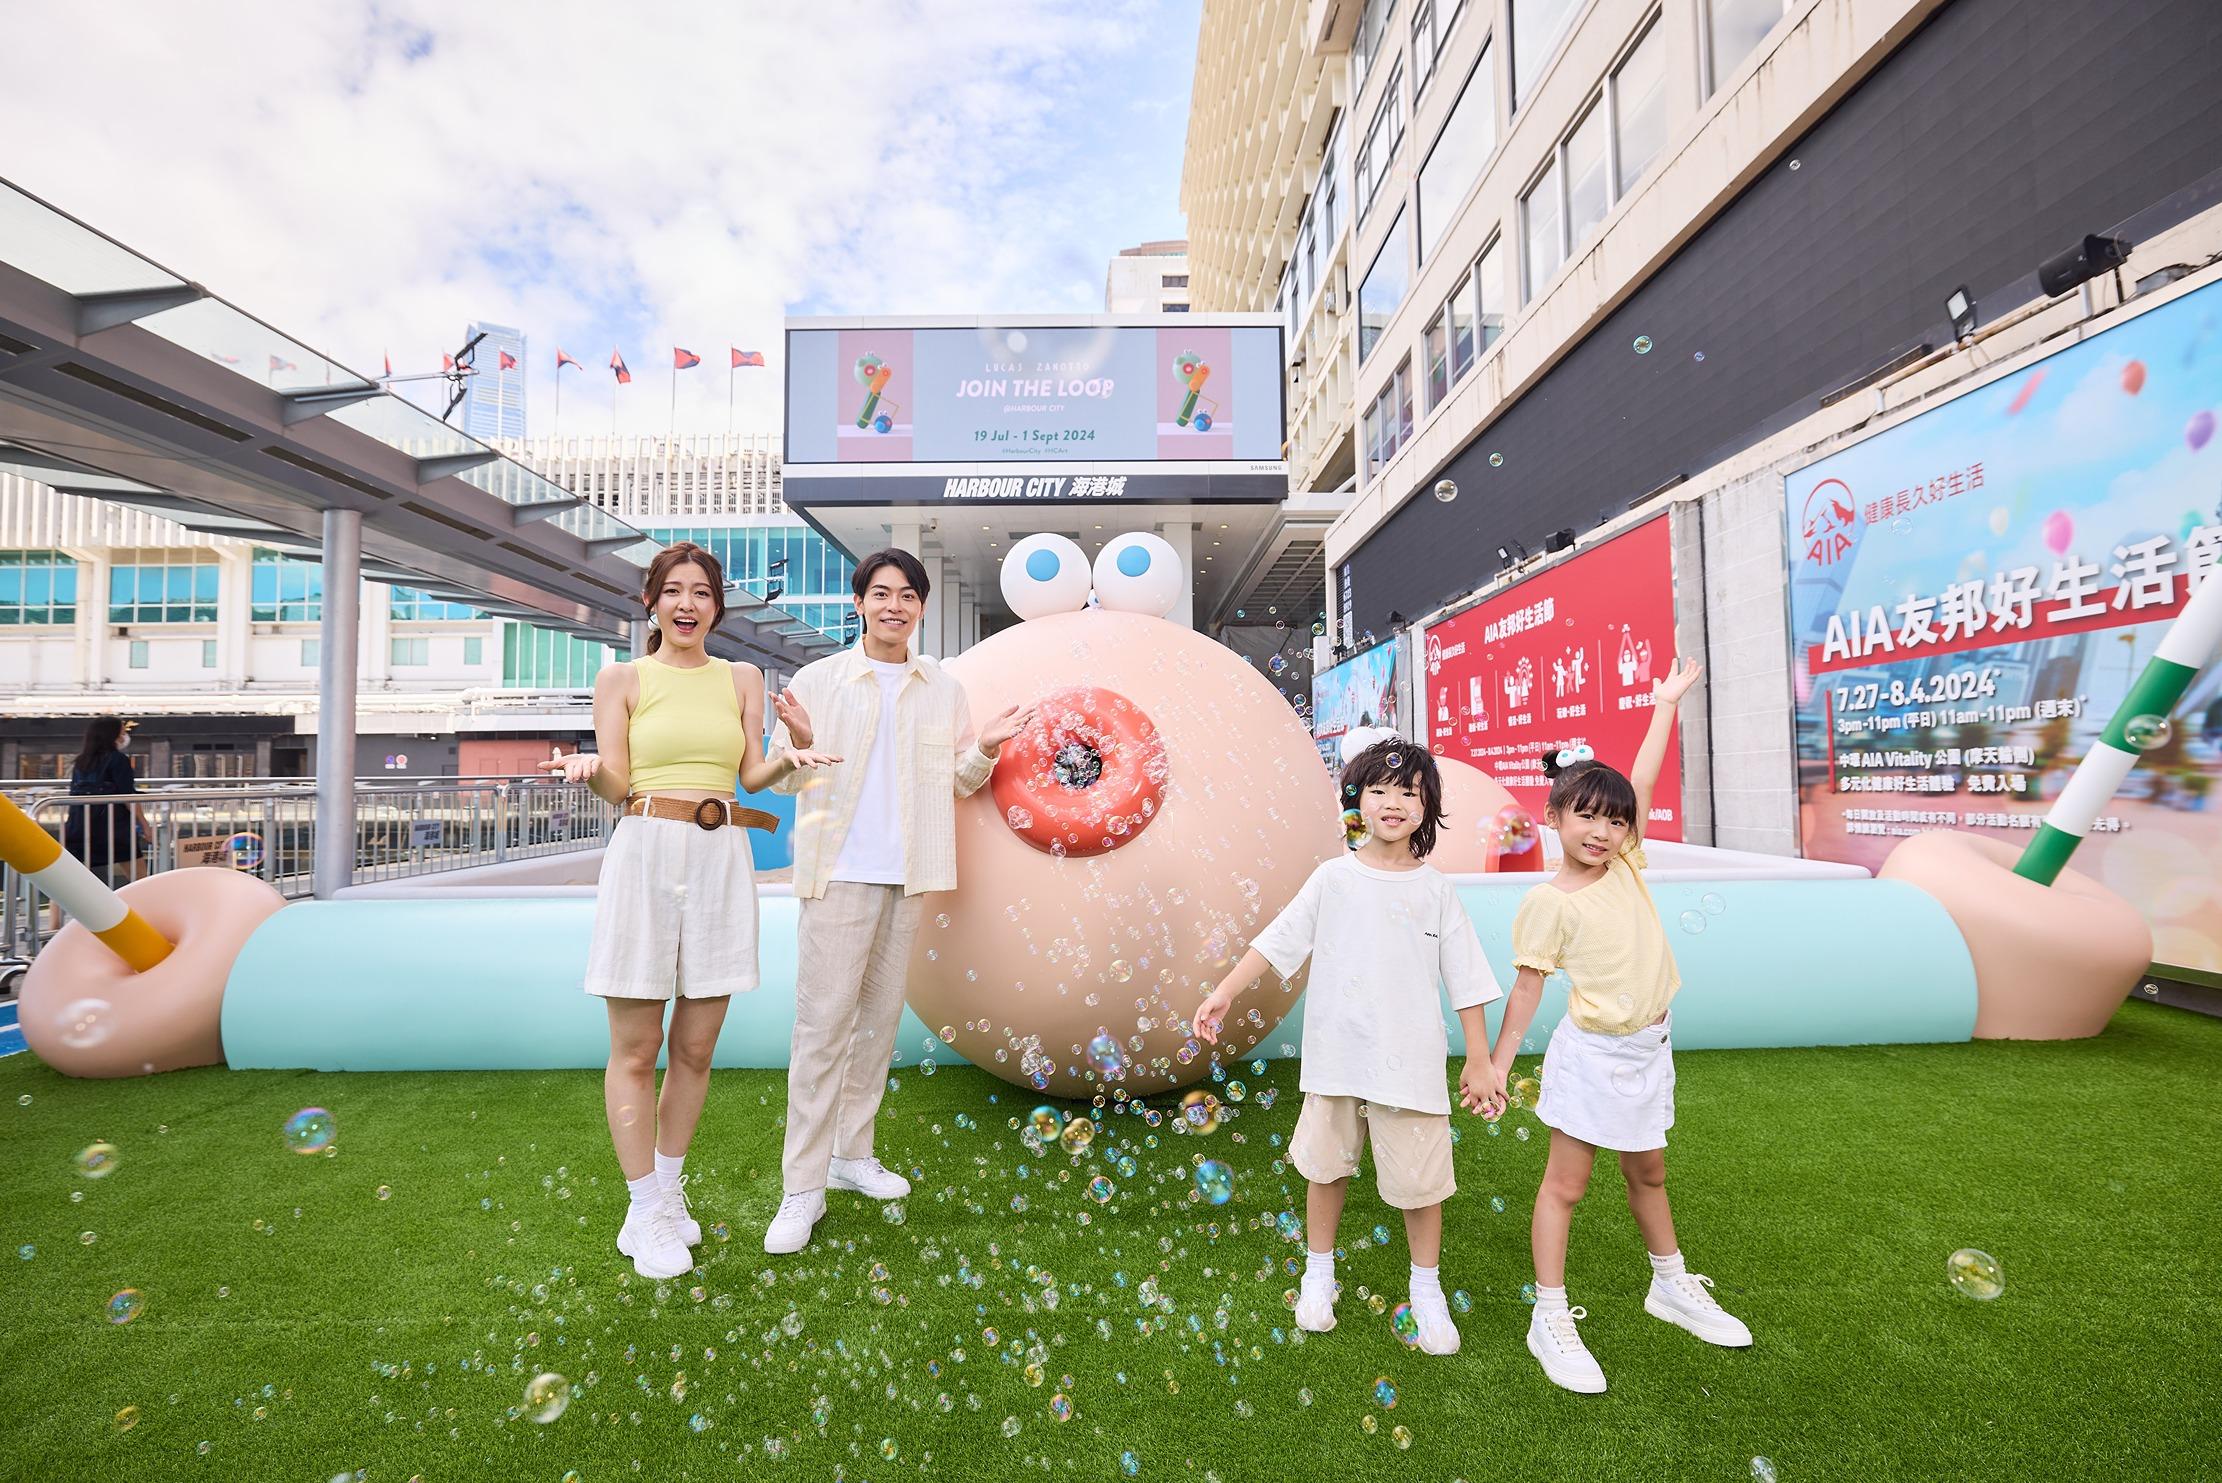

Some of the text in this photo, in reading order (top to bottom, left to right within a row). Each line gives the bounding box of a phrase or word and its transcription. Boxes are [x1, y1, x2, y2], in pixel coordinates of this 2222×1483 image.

[985, 361, 1091, 373] LUCAS ZANOTTO
[956, 379, 1114, 398] JOIN THE LOOP
[1048, 404, 1065, 413] CITY
[974, 430, 988, 442] 19
[991, 430, 1010, 442] Jul
[1022, 430, 1029, 442] 1
[1032, 429, 1060, 445] Sept
[1063, 429, 1096, 441] 2024
[1250, 464, 1283, 472] SAMSUNG
[943, 475, 1128, 499] HARBOUR CITY 海港城
[1863, 461, 1985, 526] 健康長久好生活
[1807, 532, 1853, 567] AIA
[1837, 715, 1902, 735] 3pm-11pm
[1902, 711, 1937, 730] (平日)
[1940, 703, 2033, 726] 11am-11pm
[1861, 753, 1886, 768] AIA
[1885, 751, 1934, 769] Vitality
